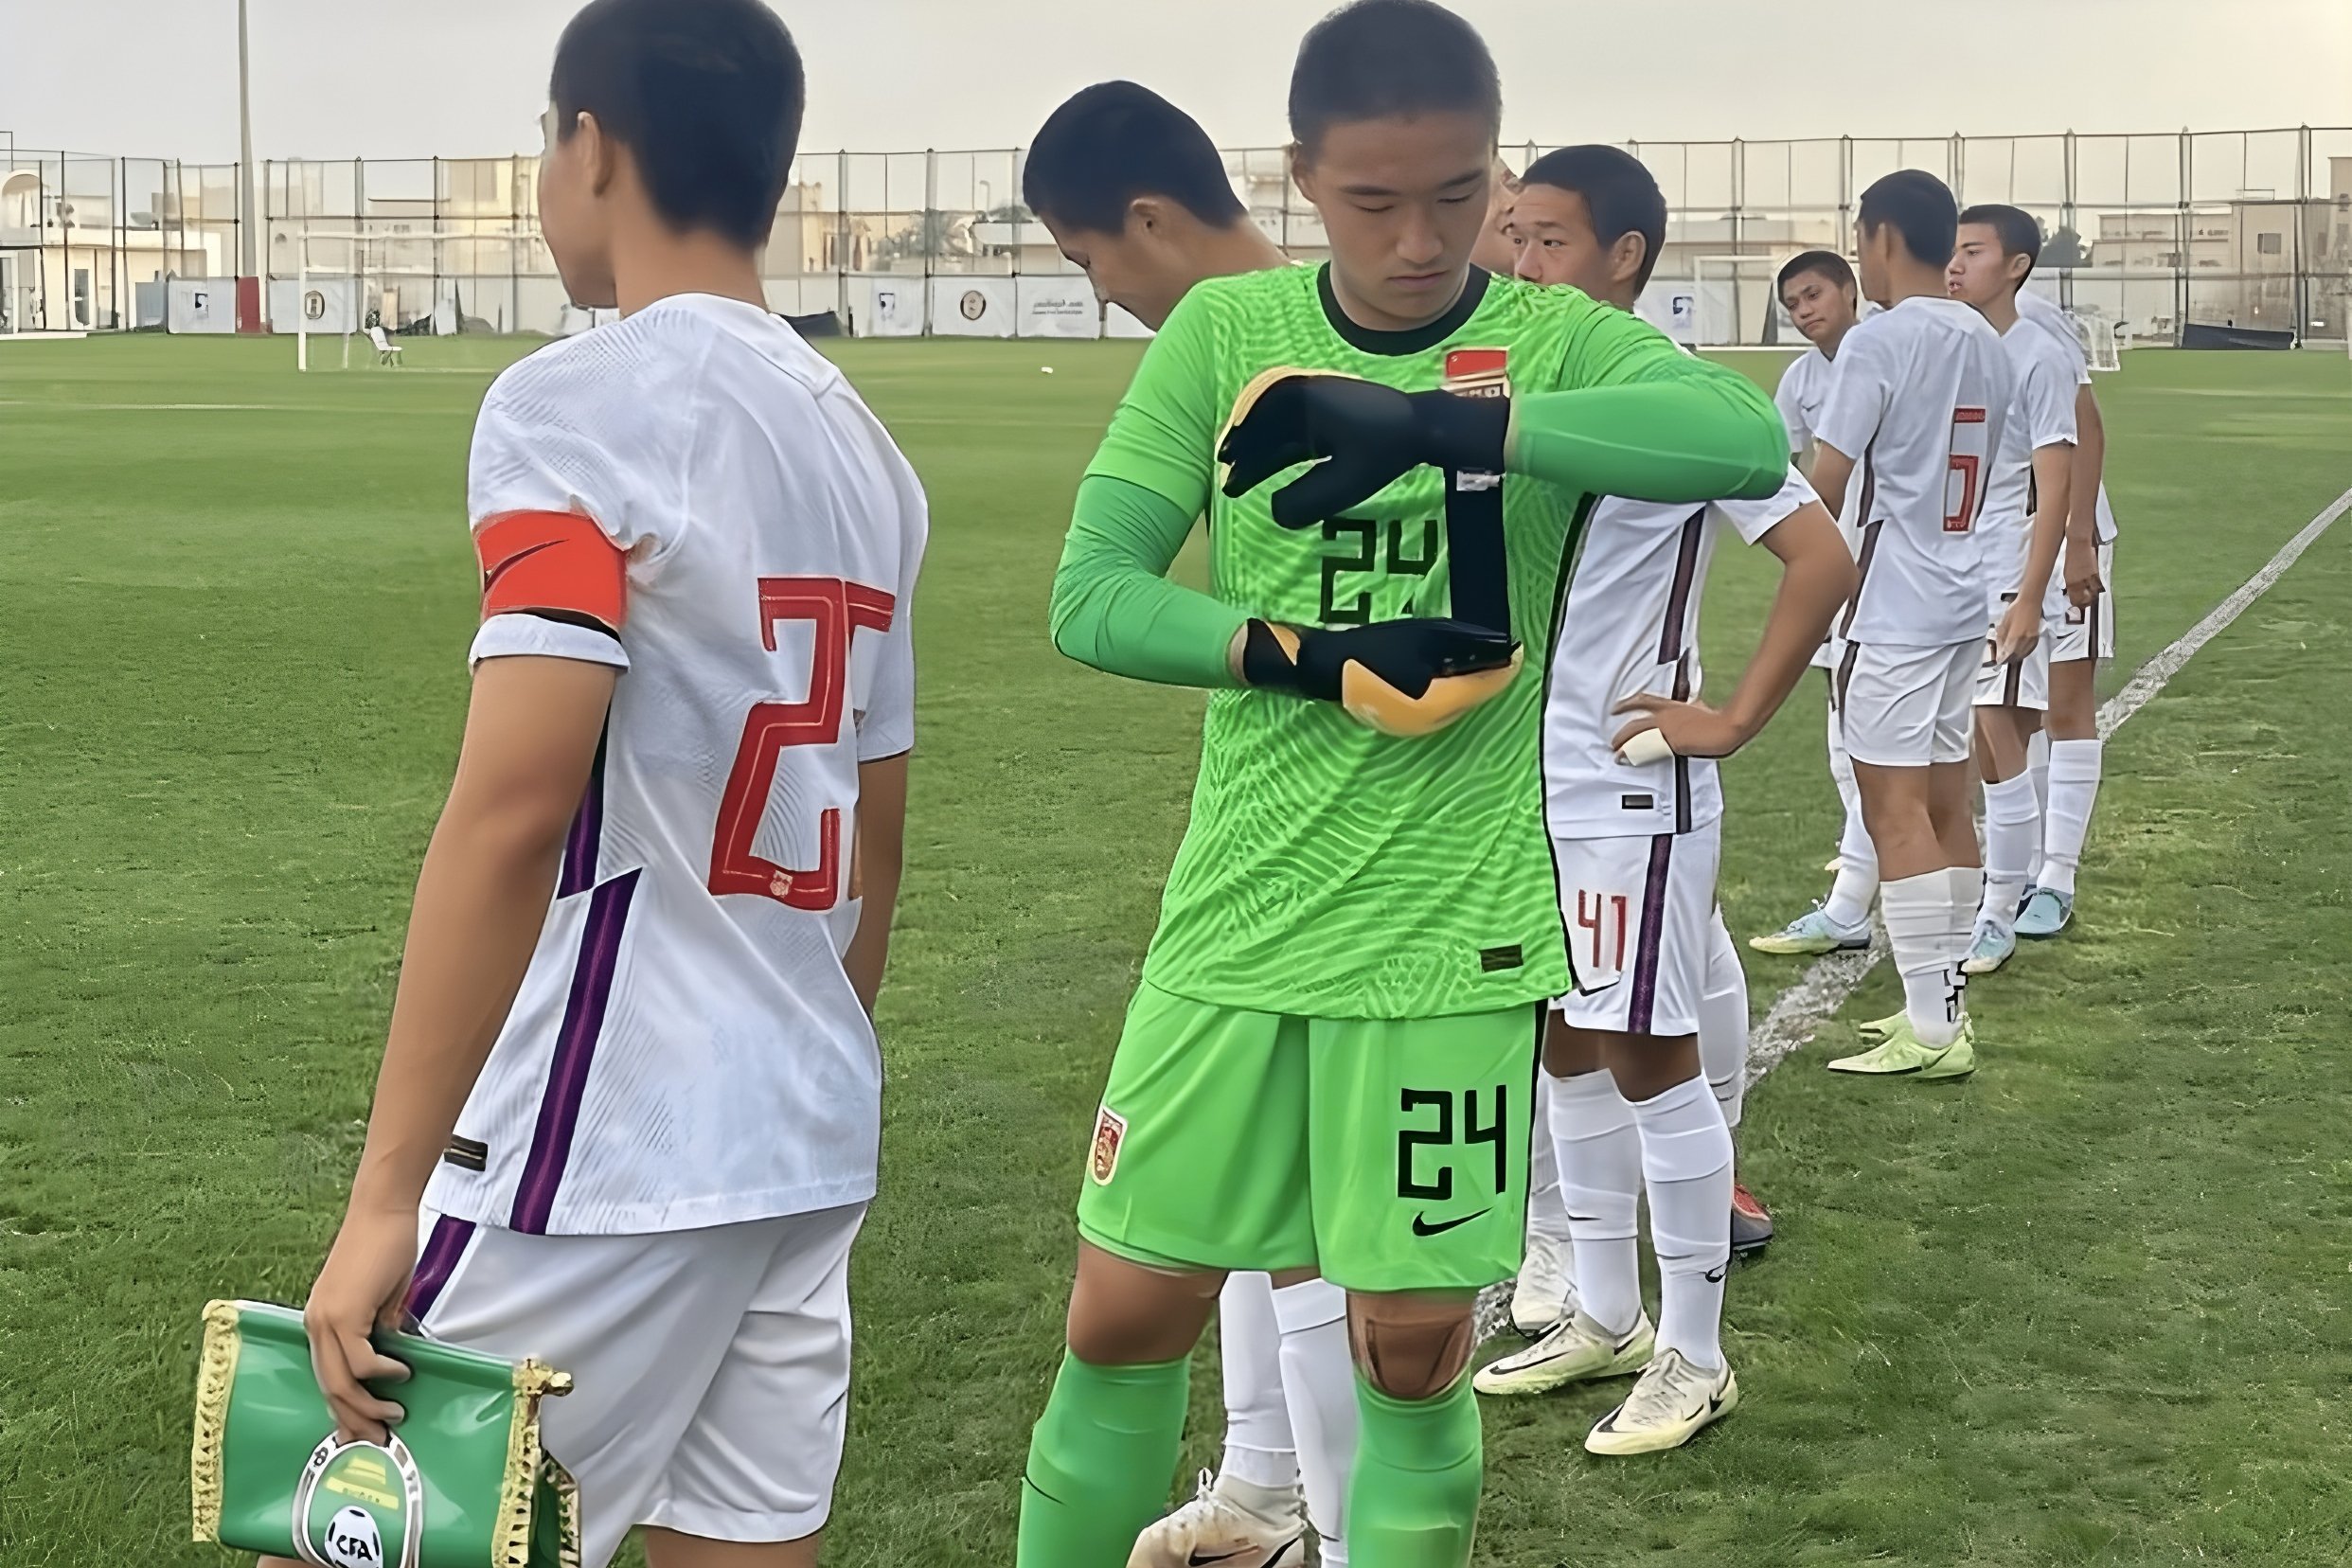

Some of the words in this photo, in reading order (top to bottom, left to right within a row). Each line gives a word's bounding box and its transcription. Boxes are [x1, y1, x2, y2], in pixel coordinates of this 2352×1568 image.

[1321, 520, 1439, 625] 24
[1577, 889, 1629, 972] 41
[1398, 1084, 1507, 1201] 24
[336, 1534, 373, 1561] CFA
